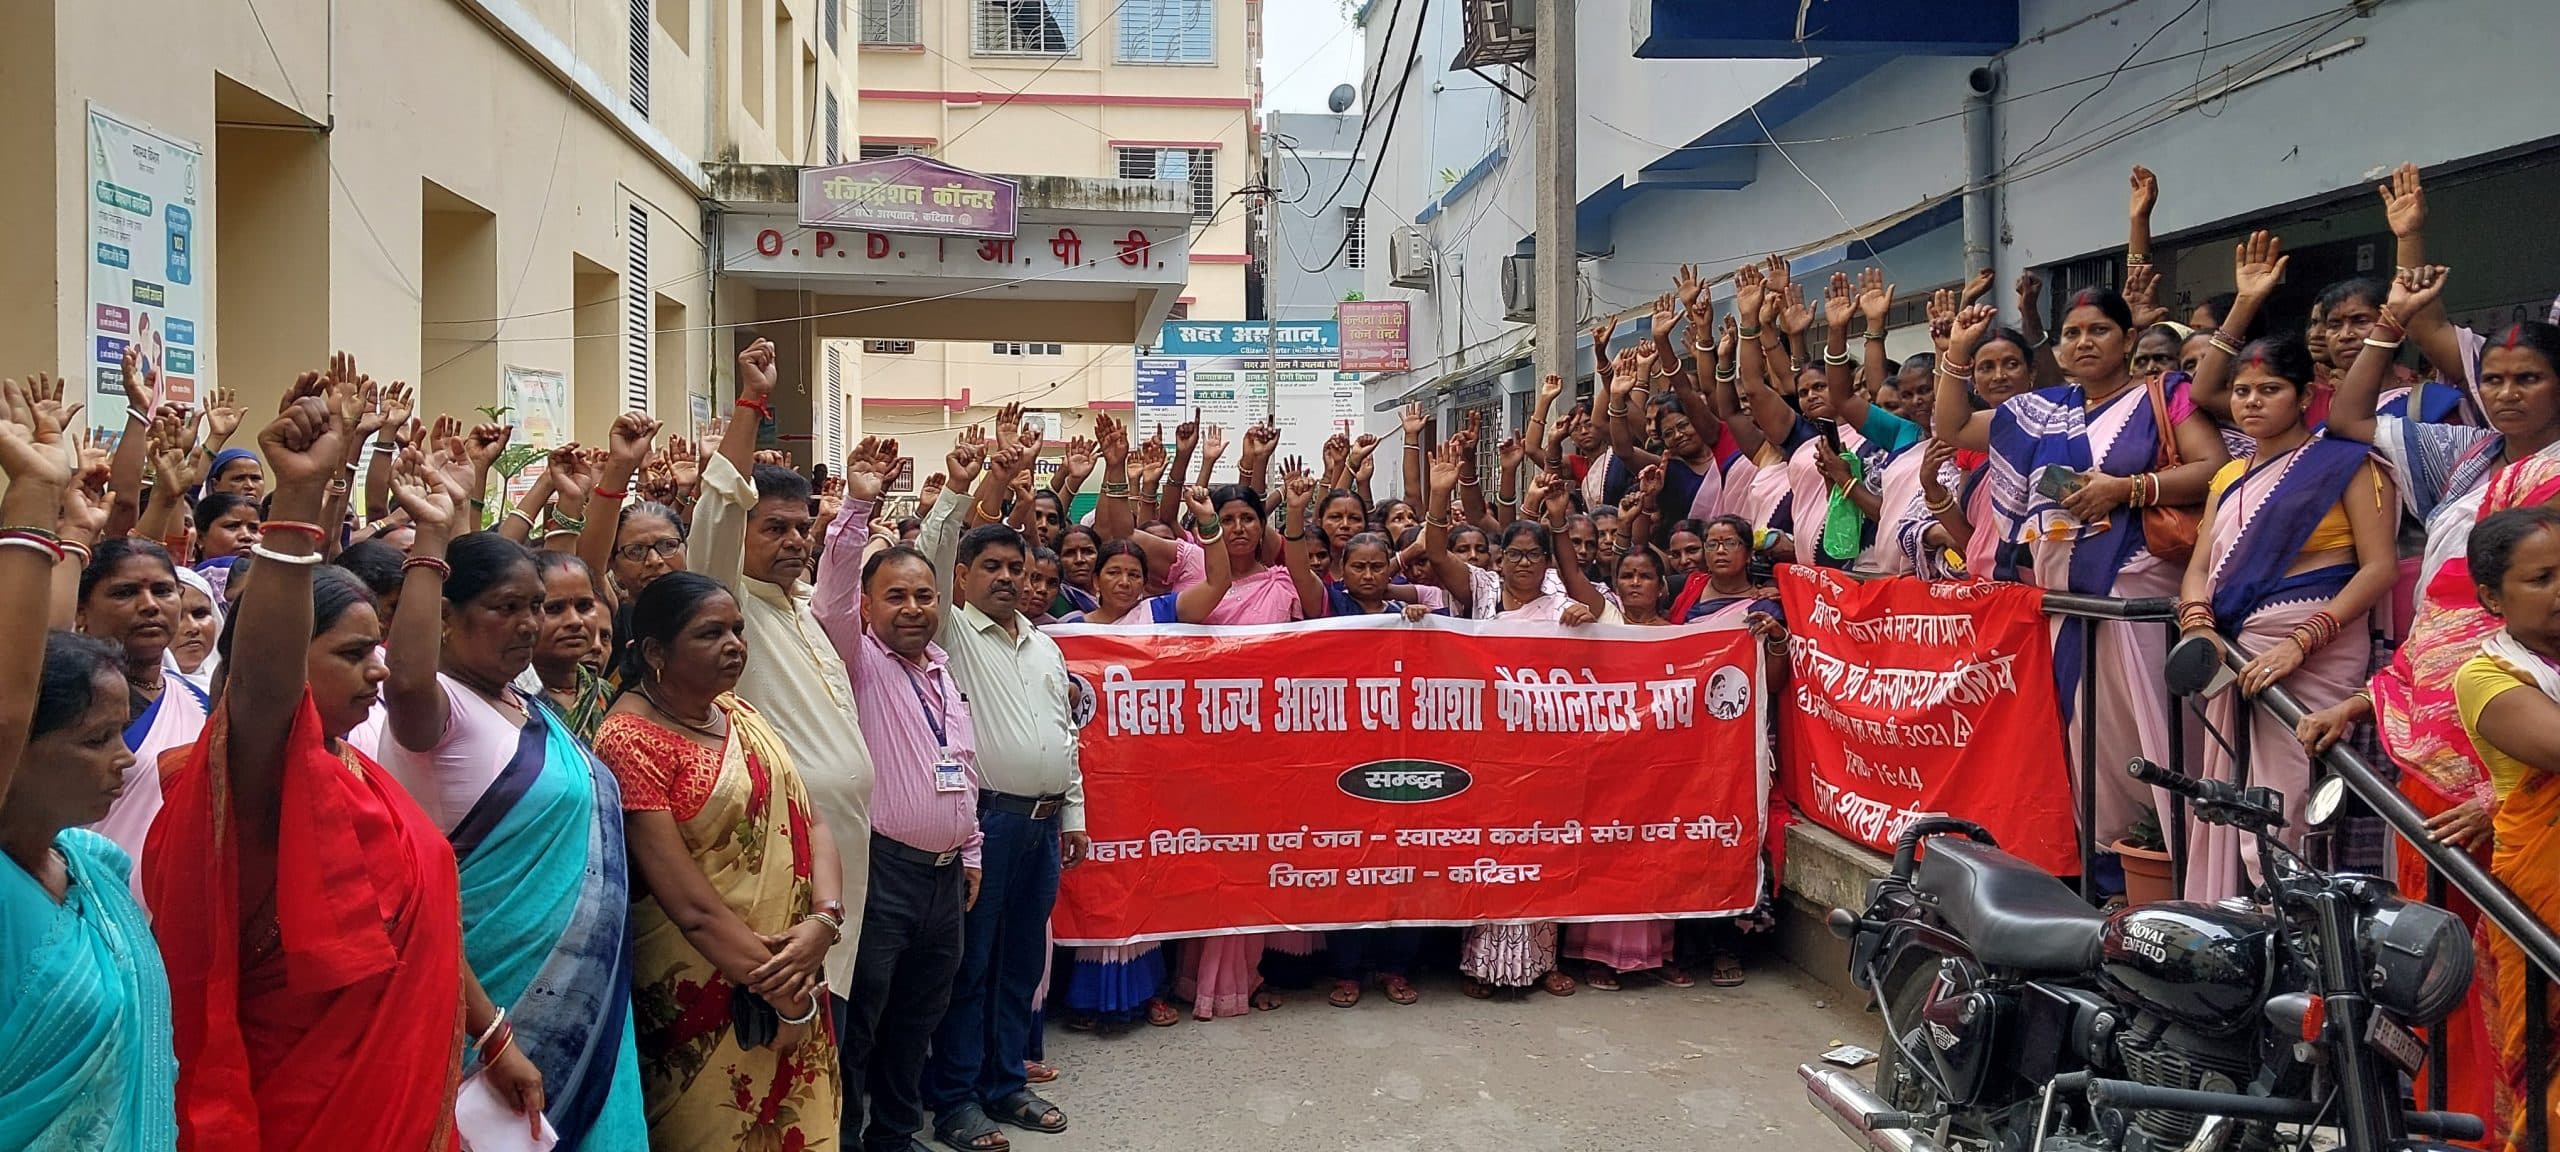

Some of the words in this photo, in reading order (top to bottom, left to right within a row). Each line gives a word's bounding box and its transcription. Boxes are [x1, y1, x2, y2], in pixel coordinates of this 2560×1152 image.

[1178, 326, 1224, 343] सदर
[1231, 326, 1328, 344] अस्ताल,
[1265, 346, 1291, 354] Carter
[1808, 593, 1841, 636] बिहार
[1102, 664, 1186, 737] बिहार
[1194, 677, 1263, 734] राज्य
[1274, 676, 1348, 732] आशा
[1356, 660, 1403, 731] एवं
[1411, 676, 1487, 732] आशा
[1494, 664, 1642, 733] फैसिलिटेटर
[1646, 663, 1698, 731] संघ
[1901, 723, 1951, 747] 3021
[1150, 828, 1260, 856] चिकित्सा
[1267, 825, 1309, 851] एवं
[1311, 830, 1363, 849] जन
[1395, 828, 1482, 847] स्वास्थ्य
[1590, 819, 1635, 843] संघ
[1640, 816, 1682, 842] एवं
[1269, 863, 1339, 888] जिला
[1346, 865, 1416, 887] शाखा
[1448, 858, 1543, 884] कटिहार
[2129, 921, 2165, 945] ROYAL
[2121, 936, 2166, 963] ENFIELD
